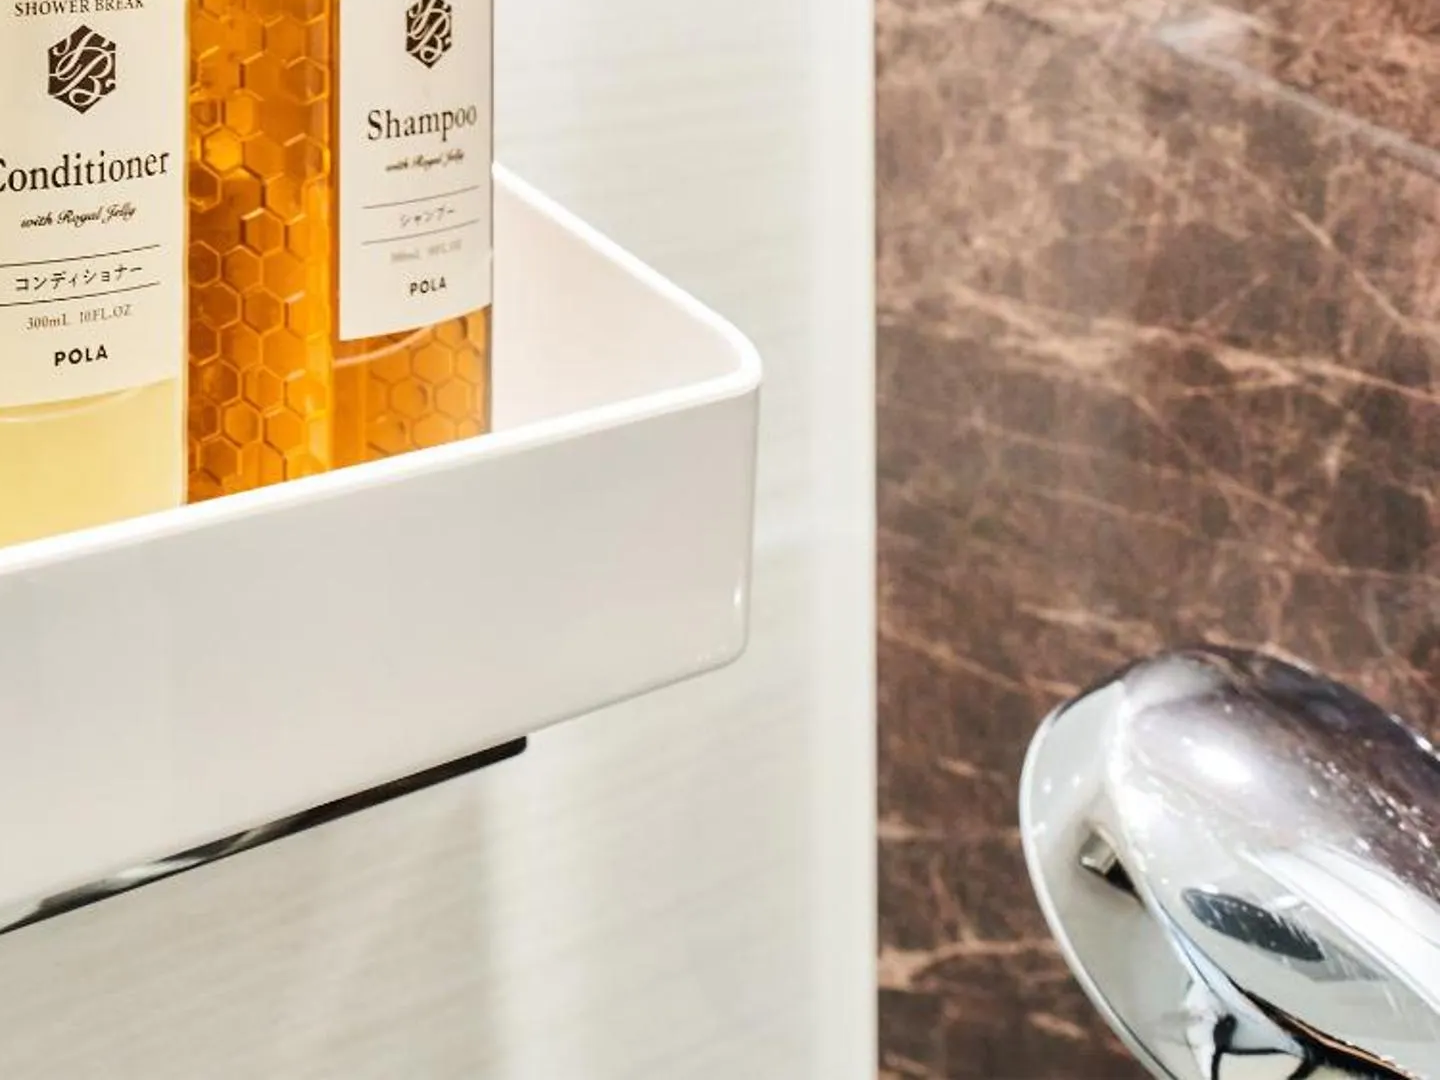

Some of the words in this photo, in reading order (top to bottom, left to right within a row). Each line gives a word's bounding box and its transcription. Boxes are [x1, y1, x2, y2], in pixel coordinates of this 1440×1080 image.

[14, 0, 90, 17] SHOWER
[367, 105, 478, 142] Shampoo
[20, 211, 53, 229] with
[57, 207, 102, 228] Royal
[101, 201, 137, 224] Jelly
[15, 264, 143, 291] コンディショナー
[410, 276, 447, 296] POLA
[26, 313, 70, 331] 300mL
[54, 344, 109, 366] POLA
